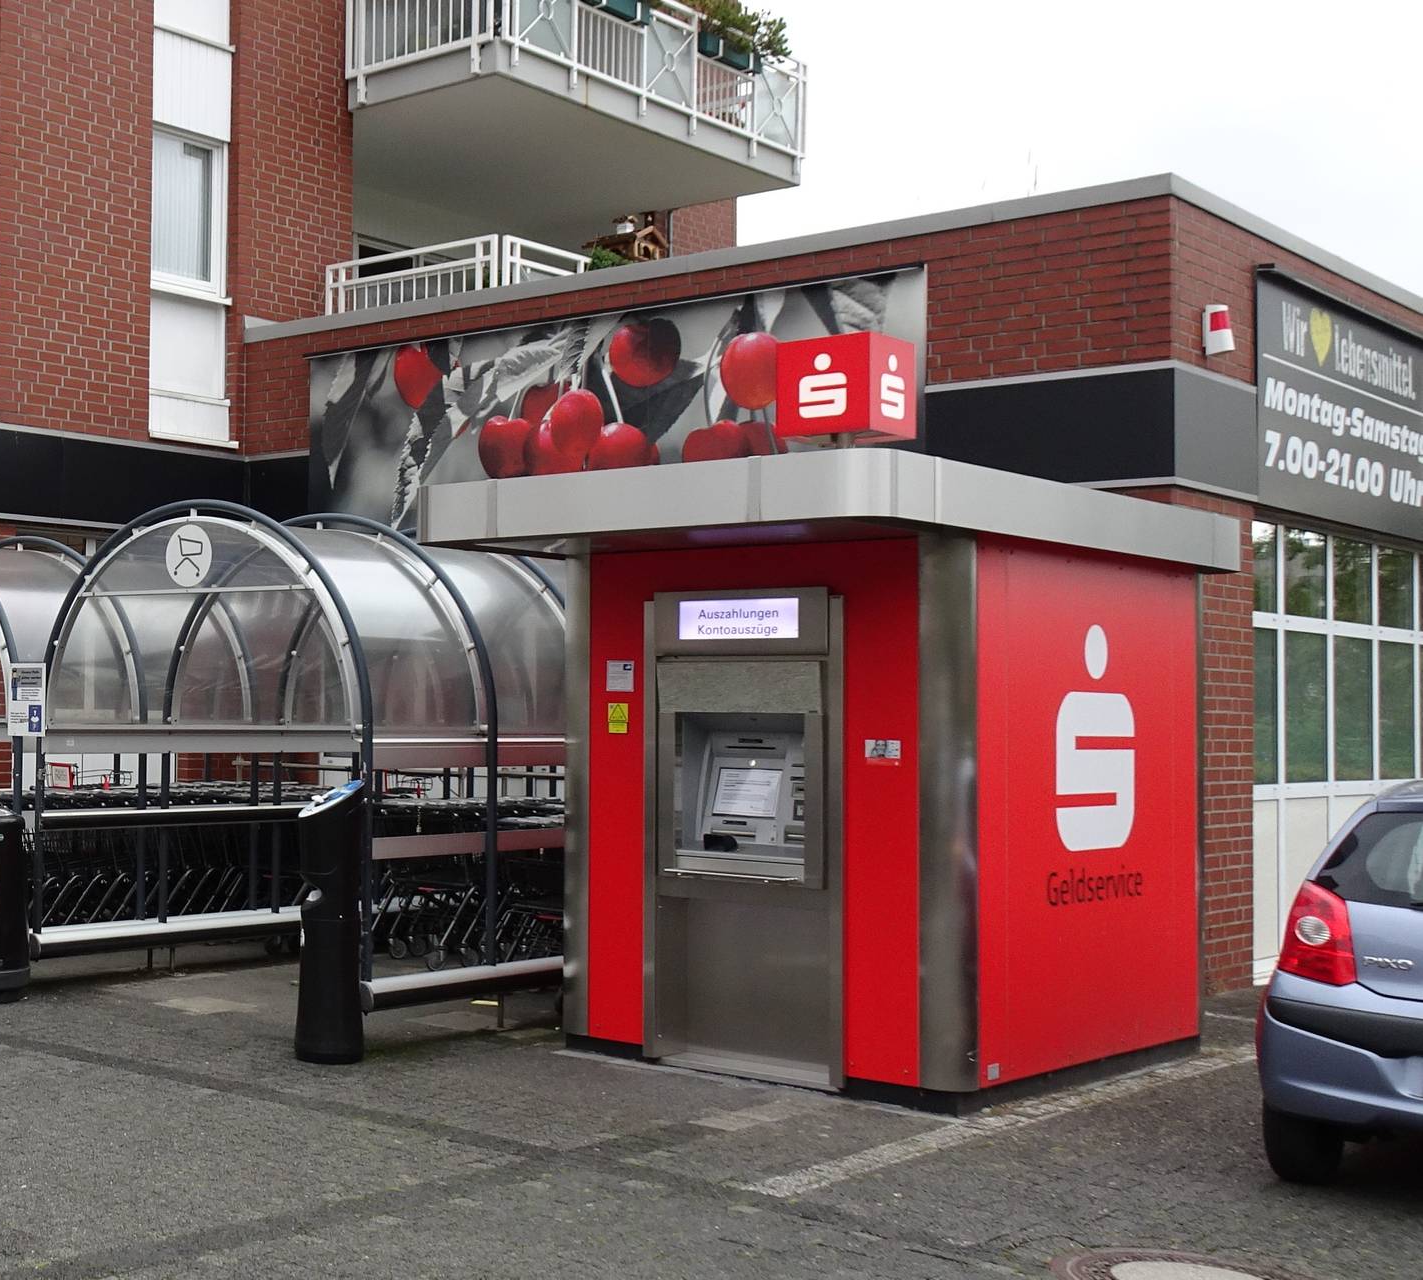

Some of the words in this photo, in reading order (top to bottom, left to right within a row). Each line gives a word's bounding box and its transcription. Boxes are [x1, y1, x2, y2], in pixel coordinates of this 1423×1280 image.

[1281, 301, 1308, 357] Wir
[1264, 429, 1384, 497] 7.00-21.00
[1389, 467, 1423, 507] Uhr
[697, 608, 779, 621] Auszahlungen
[697, 623, 778, 637] Kontoauszüge
[1046, 864, 1143, 907] Geldservice
